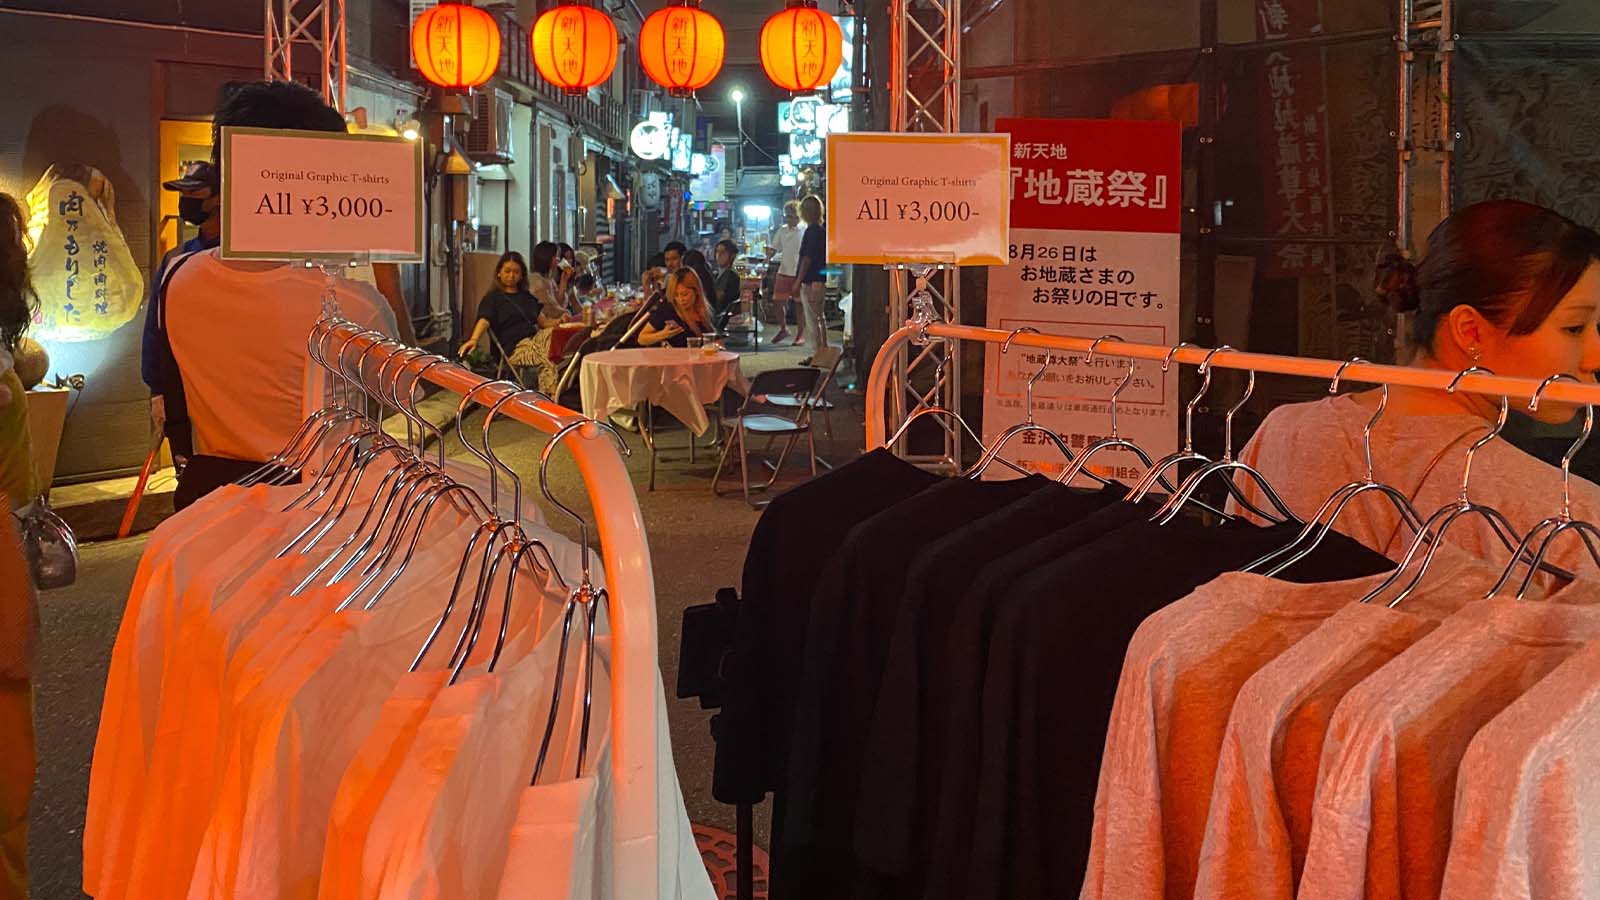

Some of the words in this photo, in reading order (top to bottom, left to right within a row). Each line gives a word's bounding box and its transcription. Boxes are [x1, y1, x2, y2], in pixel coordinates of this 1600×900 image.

[436, 15, 455, 74] 新天地
[560, 15, 578, 75] 新天地
[671, 16, 688, 75] 新天地
[801, 17, 818, 77] 新天地
[1013, 143, 1068, 160] 新天地
[260, 169, 304, 183] Original
[306, 171, 349, 184] Graphic
[350, 173, 390, 184] T-shirts
[861, 175, 899, 188] Original
[901, 176, 938, 189] Graphic
[941, 177, 977, 187] T-shirts
[1009, 167, 1167, 209] 『地蔵祭』
[254, 192, 292, 216] All
[301, 195, 393, 220] ¥3,000-
[856, 199, 889, 221] All
[896, 200, 980, 223] ¥3,000-
[1009, 244, 1097, 262] 8月26日は
[1021, 265, 1135, 285] お地蔵さまの
[1032, 287, 1164, 310] お祭りの日です。
